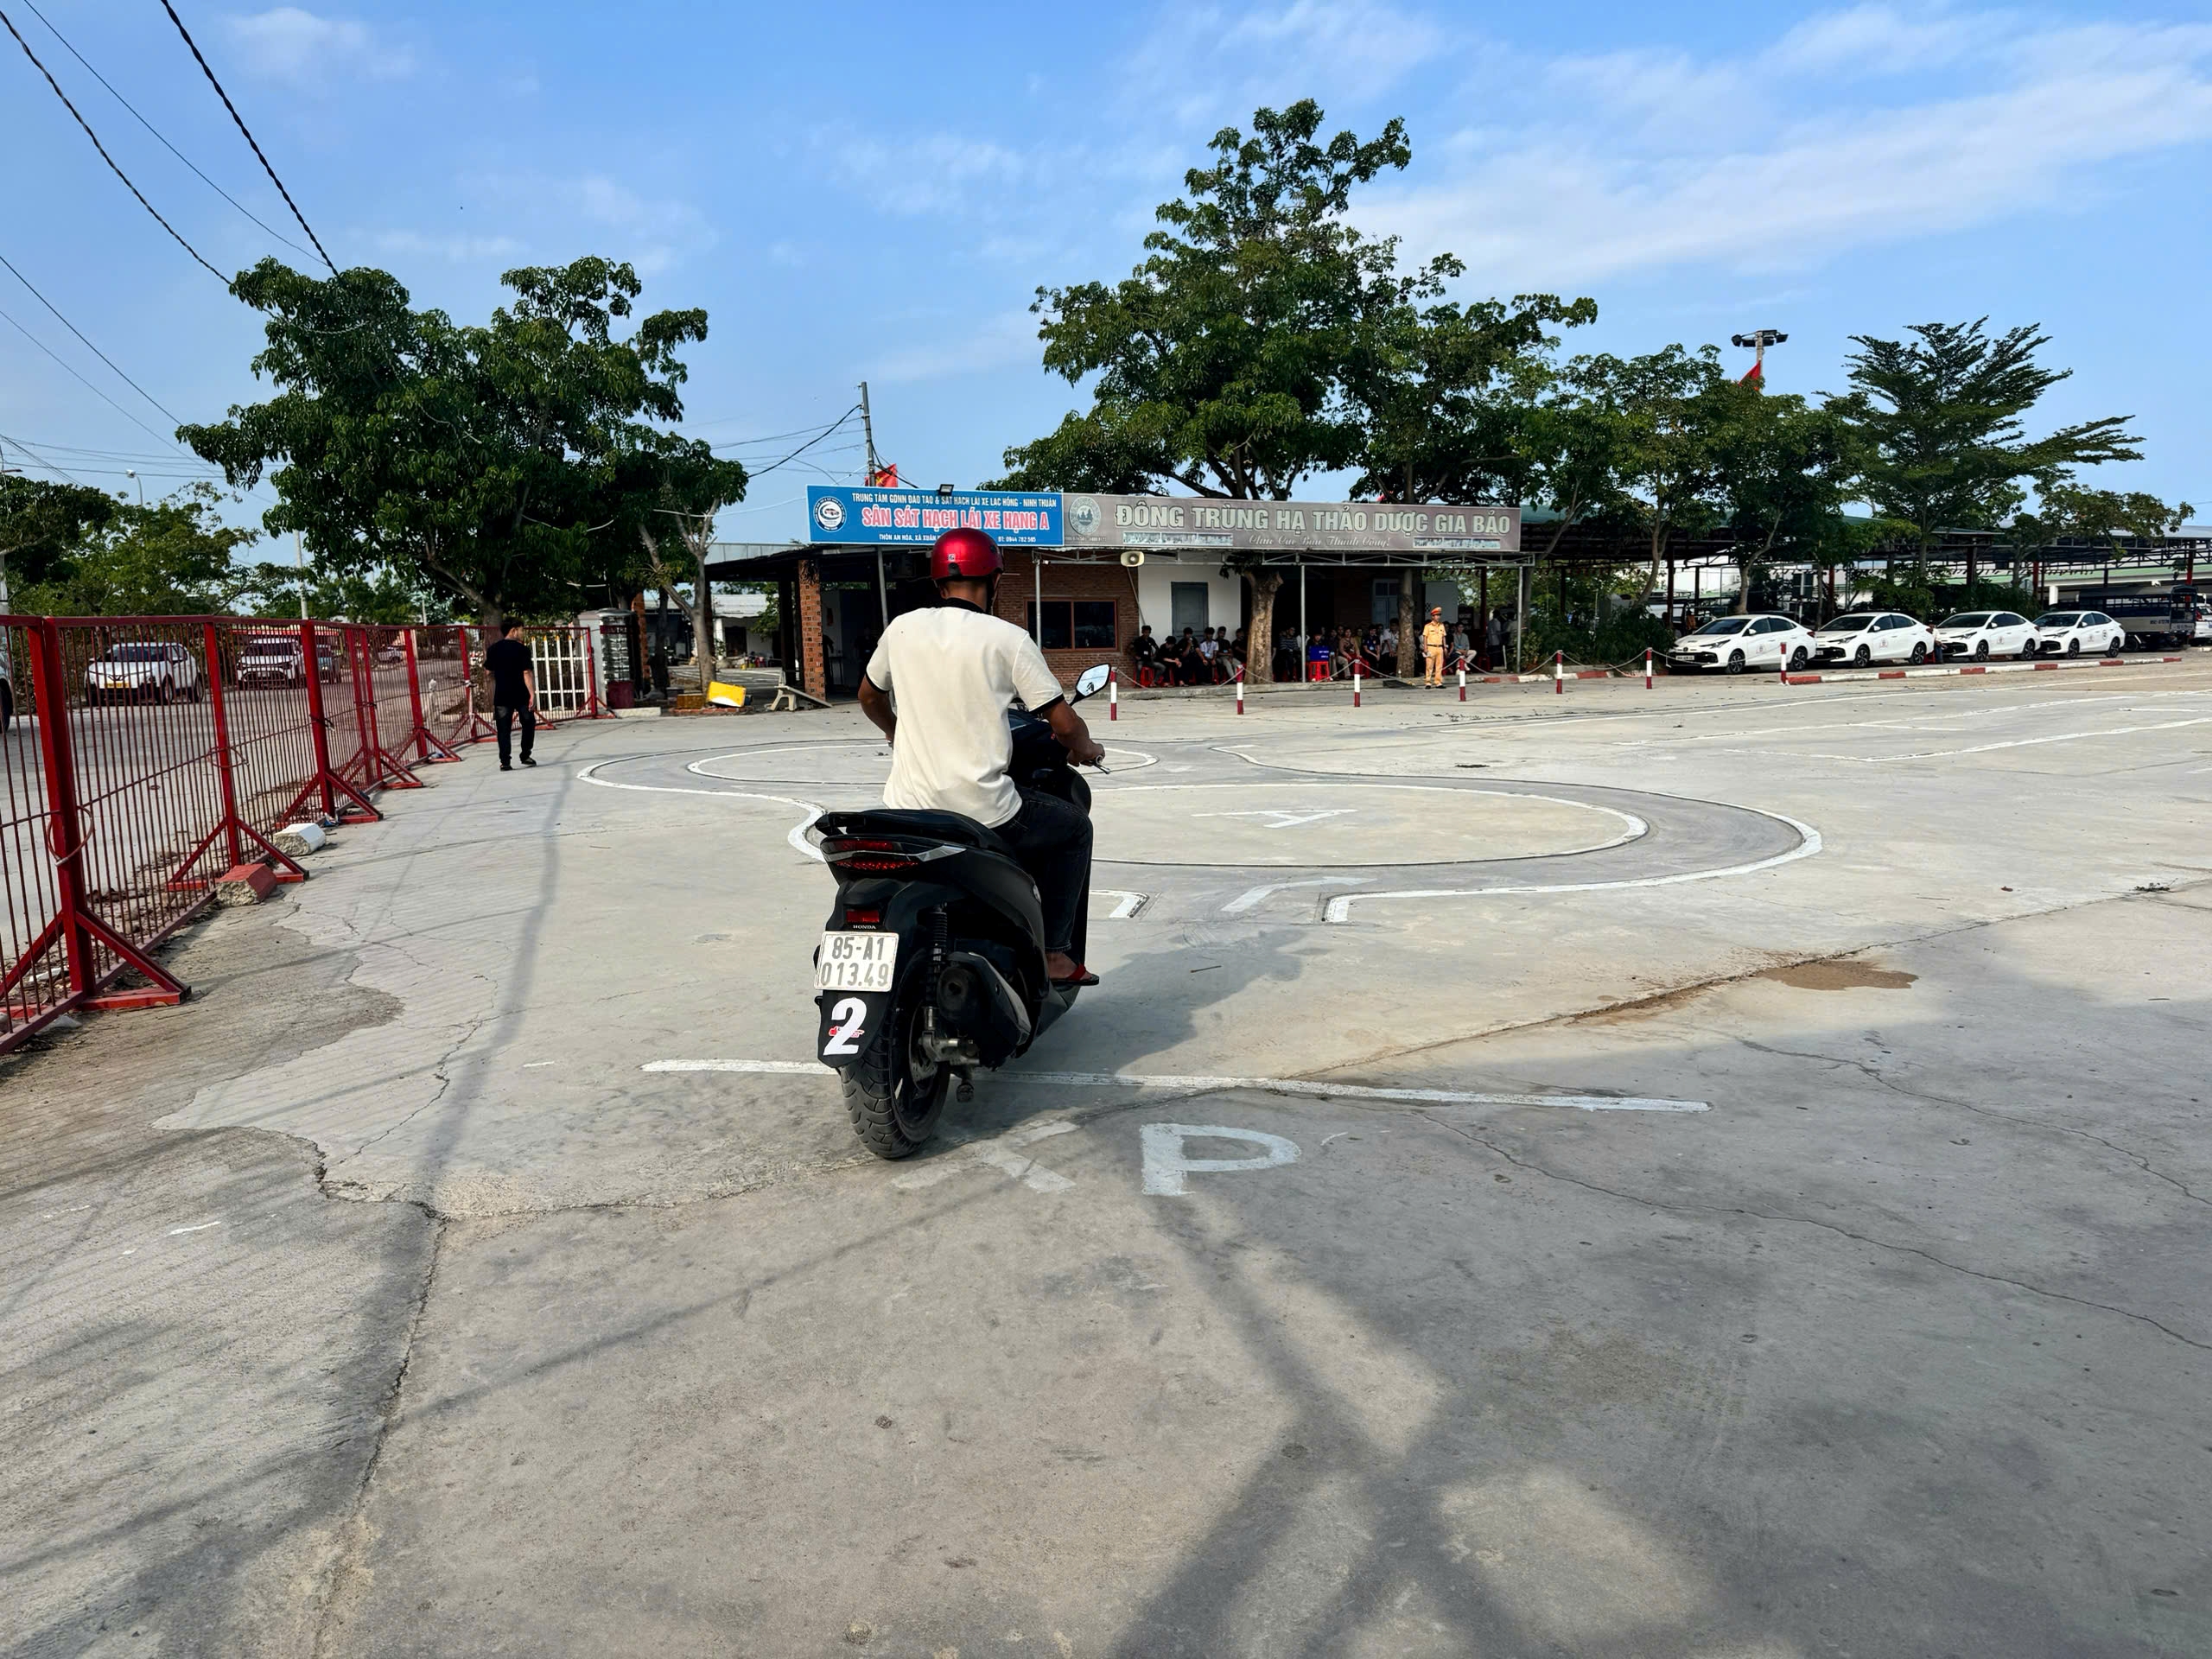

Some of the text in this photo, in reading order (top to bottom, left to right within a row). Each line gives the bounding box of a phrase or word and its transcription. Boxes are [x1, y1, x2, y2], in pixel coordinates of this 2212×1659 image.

[852, 493, 873, 503] TRUNG
[935, 496, 939, 505] &
[982, 497, 989, 505] XE
[1023, 499, 1037, 507] NINH
[862, 504, 892, 527] SÂN
[894, 505, 920, 527] SÁT
[923, 509, 958, 531] HẠCH
[960, 506, 982, 529] LÁI
[983, 510, 1001, 529] XE
[1003, 511, 1038, 533] HẠNG
[1039, 512, 1050, 530] A
[1116, 499, 1510, 537] ĐÔNG TRÙNG HẠ THẢO DƯỢC GIA BẢO
[831, 936, 885, 961] 85-A1
[820, 962, 889, 987] 013.49
[823, 997, 868, 1056] 2
